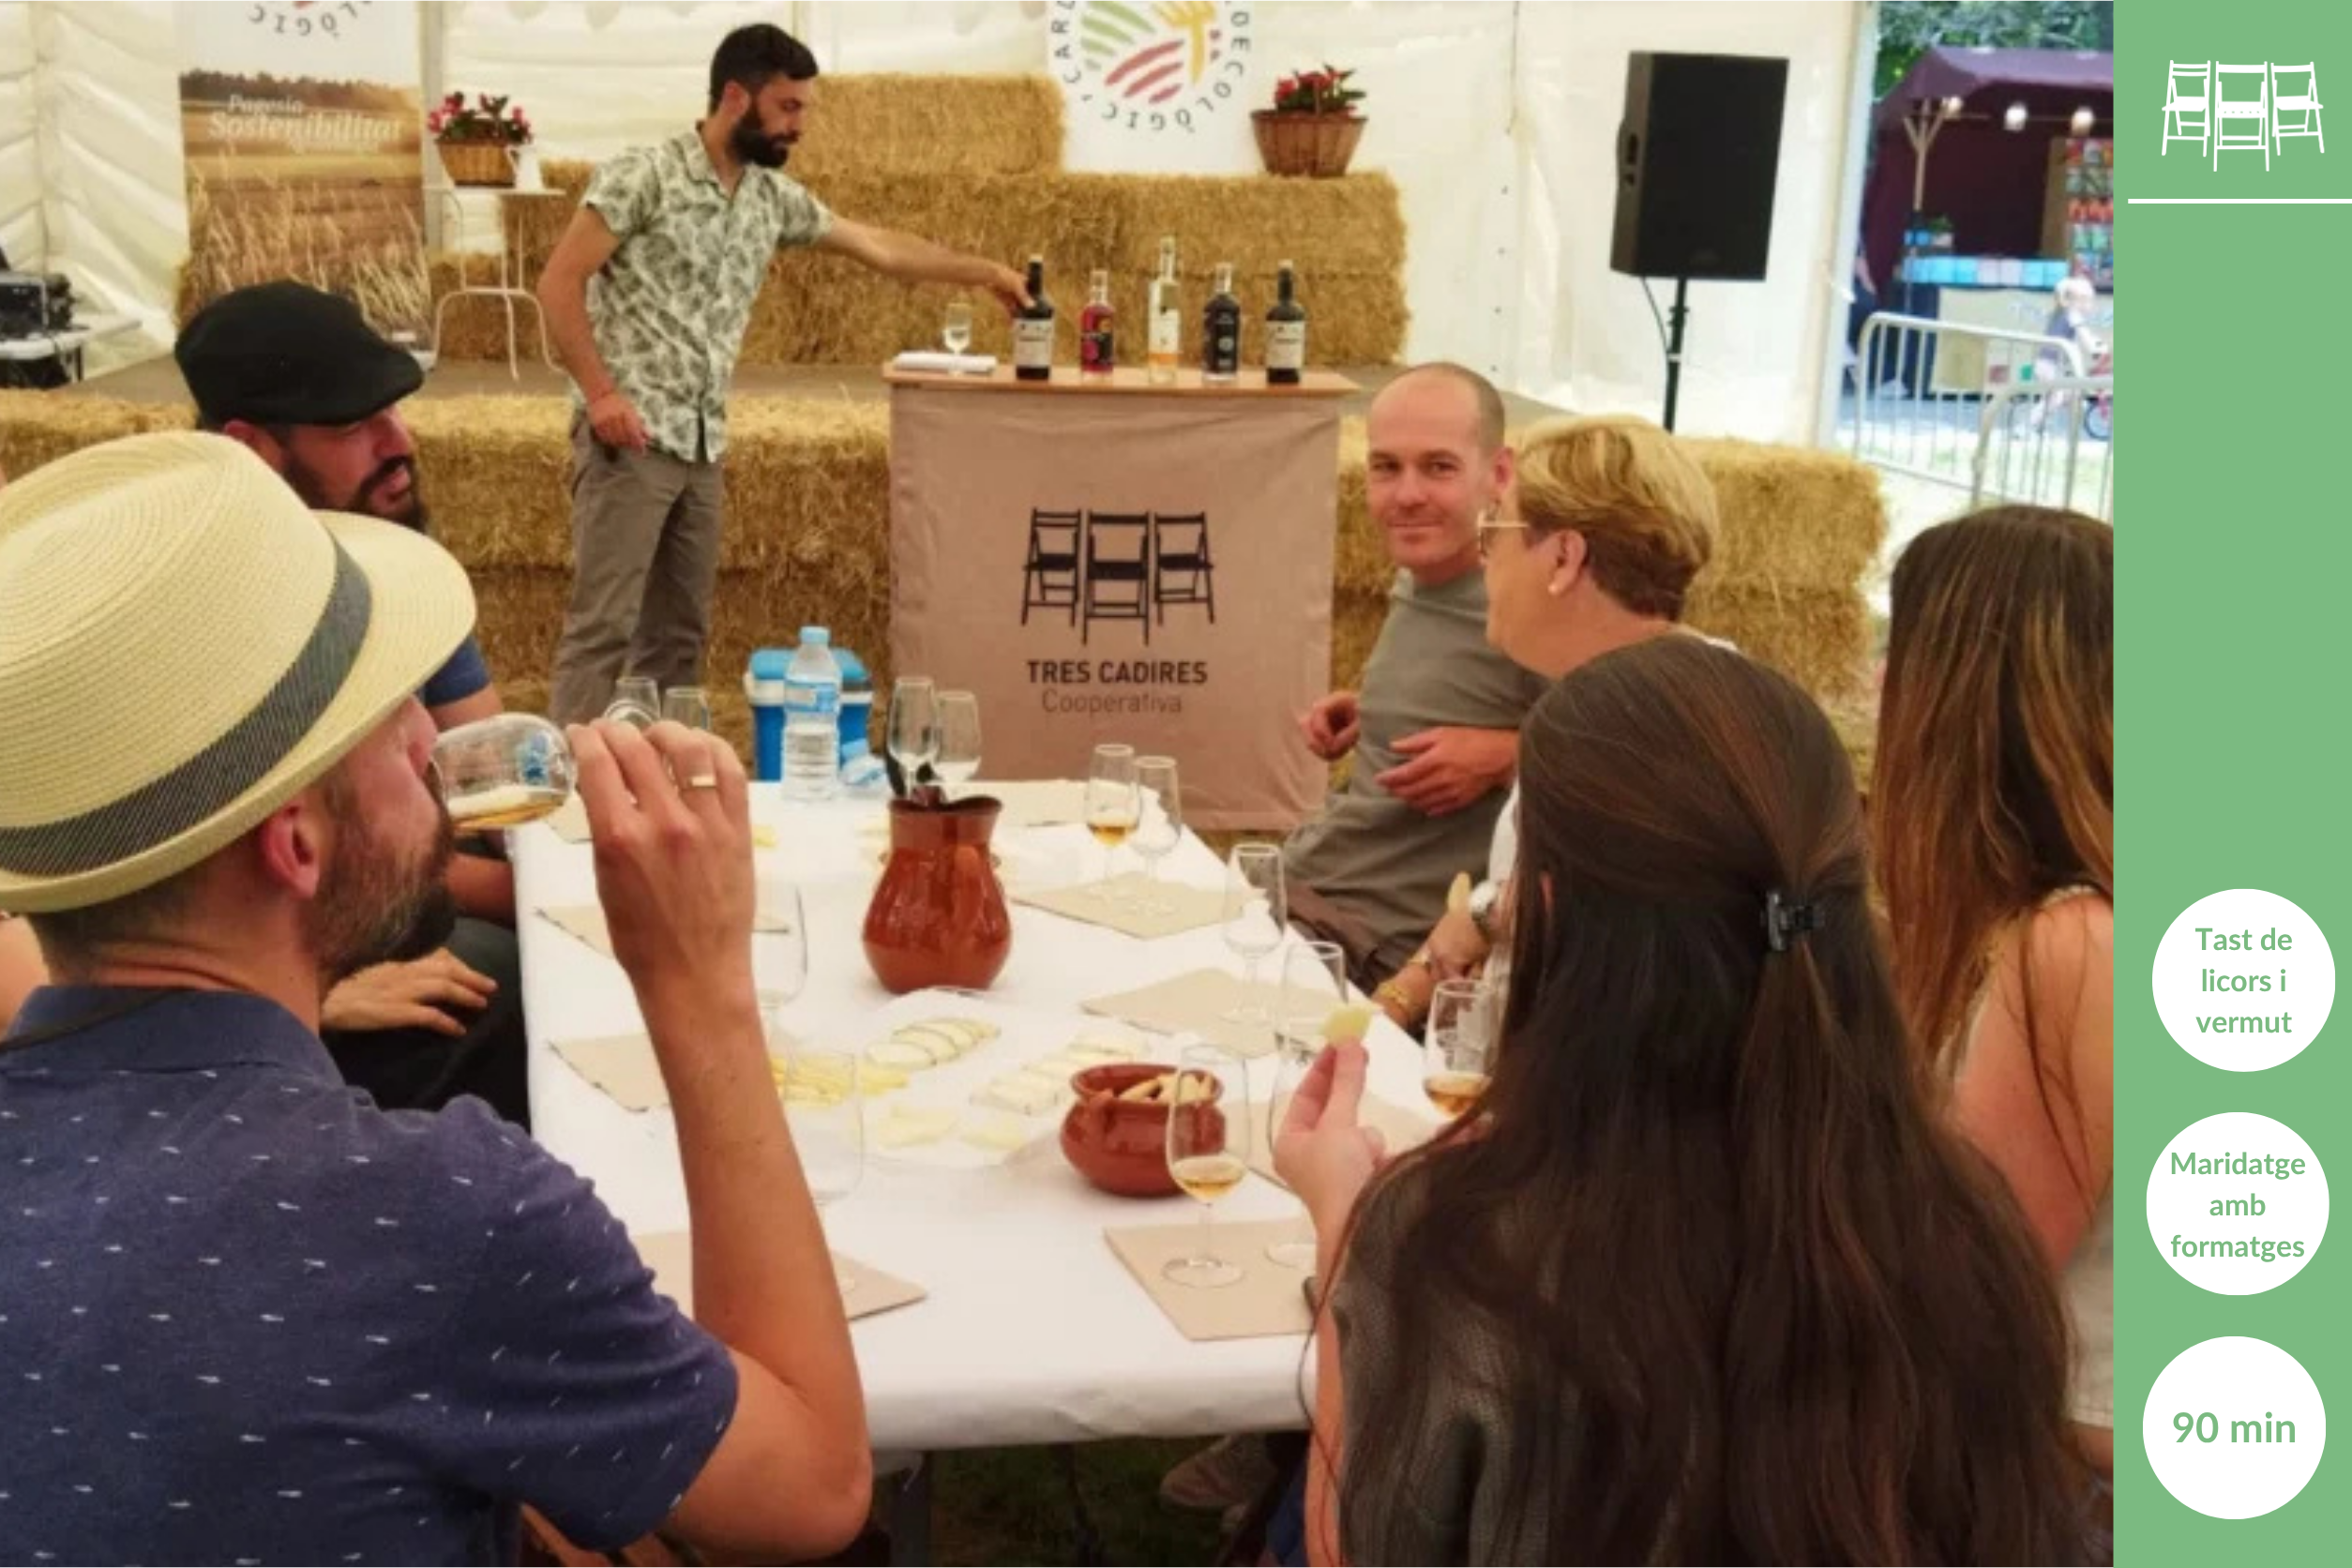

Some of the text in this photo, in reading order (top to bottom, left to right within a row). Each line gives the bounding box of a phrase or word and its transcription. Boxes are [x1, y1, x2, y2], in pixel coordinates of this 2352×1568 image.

[247, 1, 372, 39] LÒGIC
[208, 110, 404, 141] Sostenibilitat
[1027, 660, 1208, 685] TRES CADIRES
[1041, 687, 1183, 719] Cooperativa
